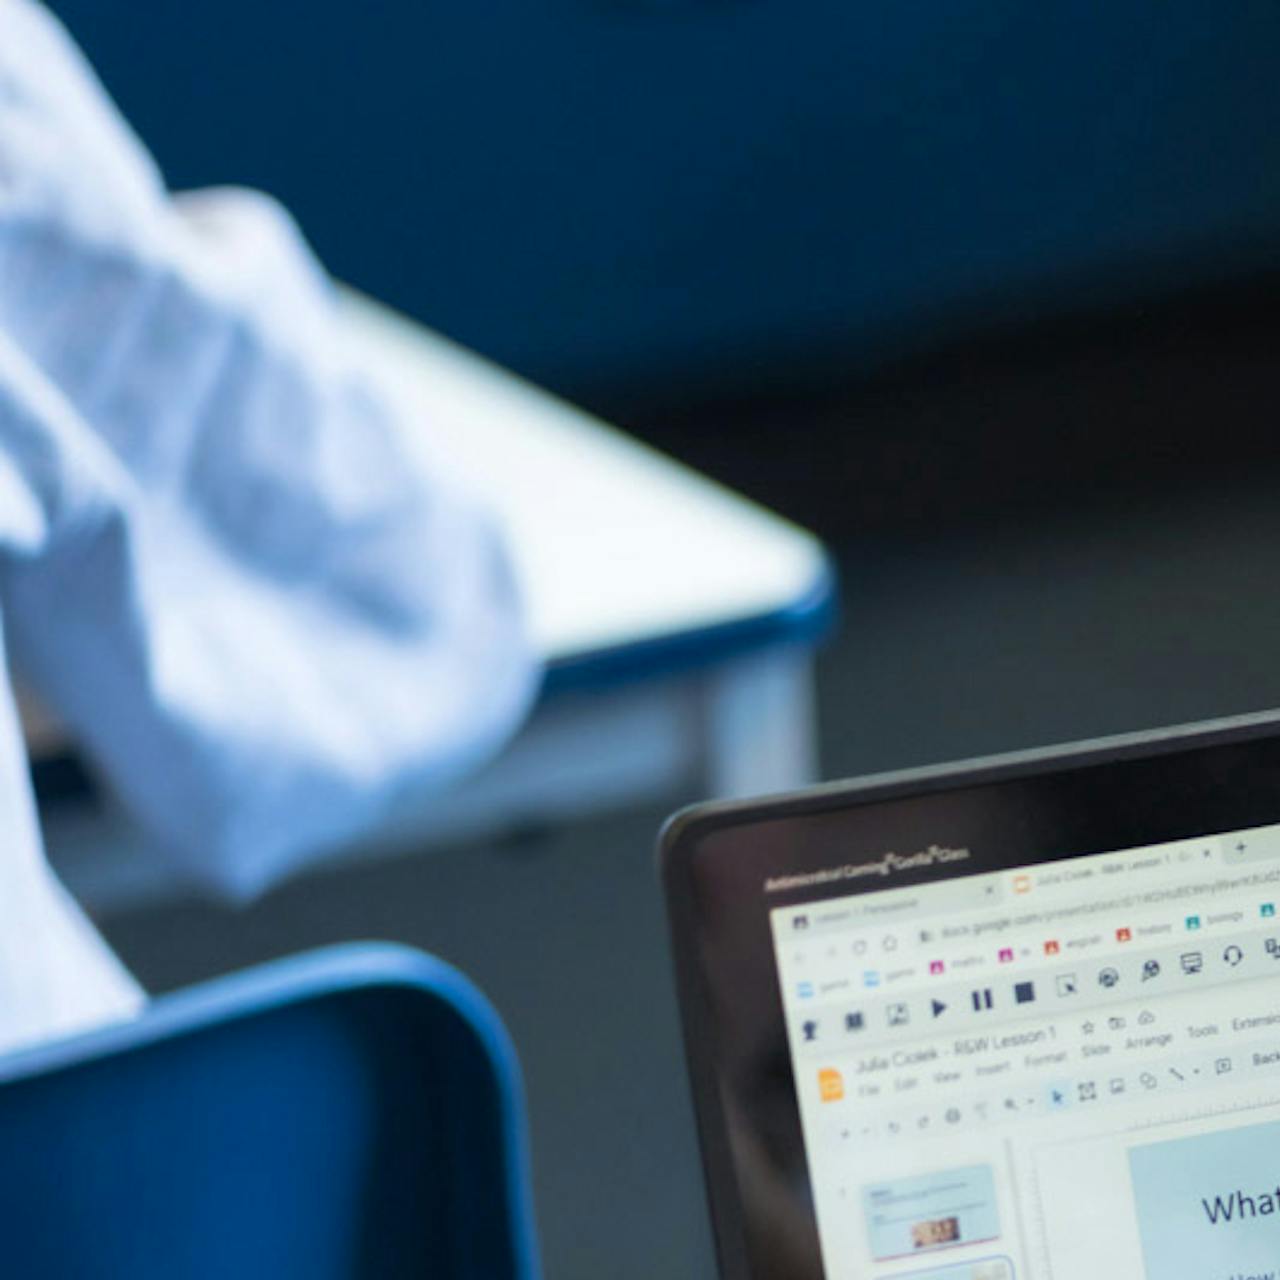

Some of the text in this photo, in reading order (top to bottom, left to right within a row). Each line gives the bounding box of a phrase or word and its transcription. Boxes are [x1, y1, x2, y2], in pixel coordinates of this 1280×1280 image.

[994, 1029, 1046, 1050] Lesson
[1125, 1032, 1173, 1049] Arrange
[1187, 1025, 1219, 1038] Tools
